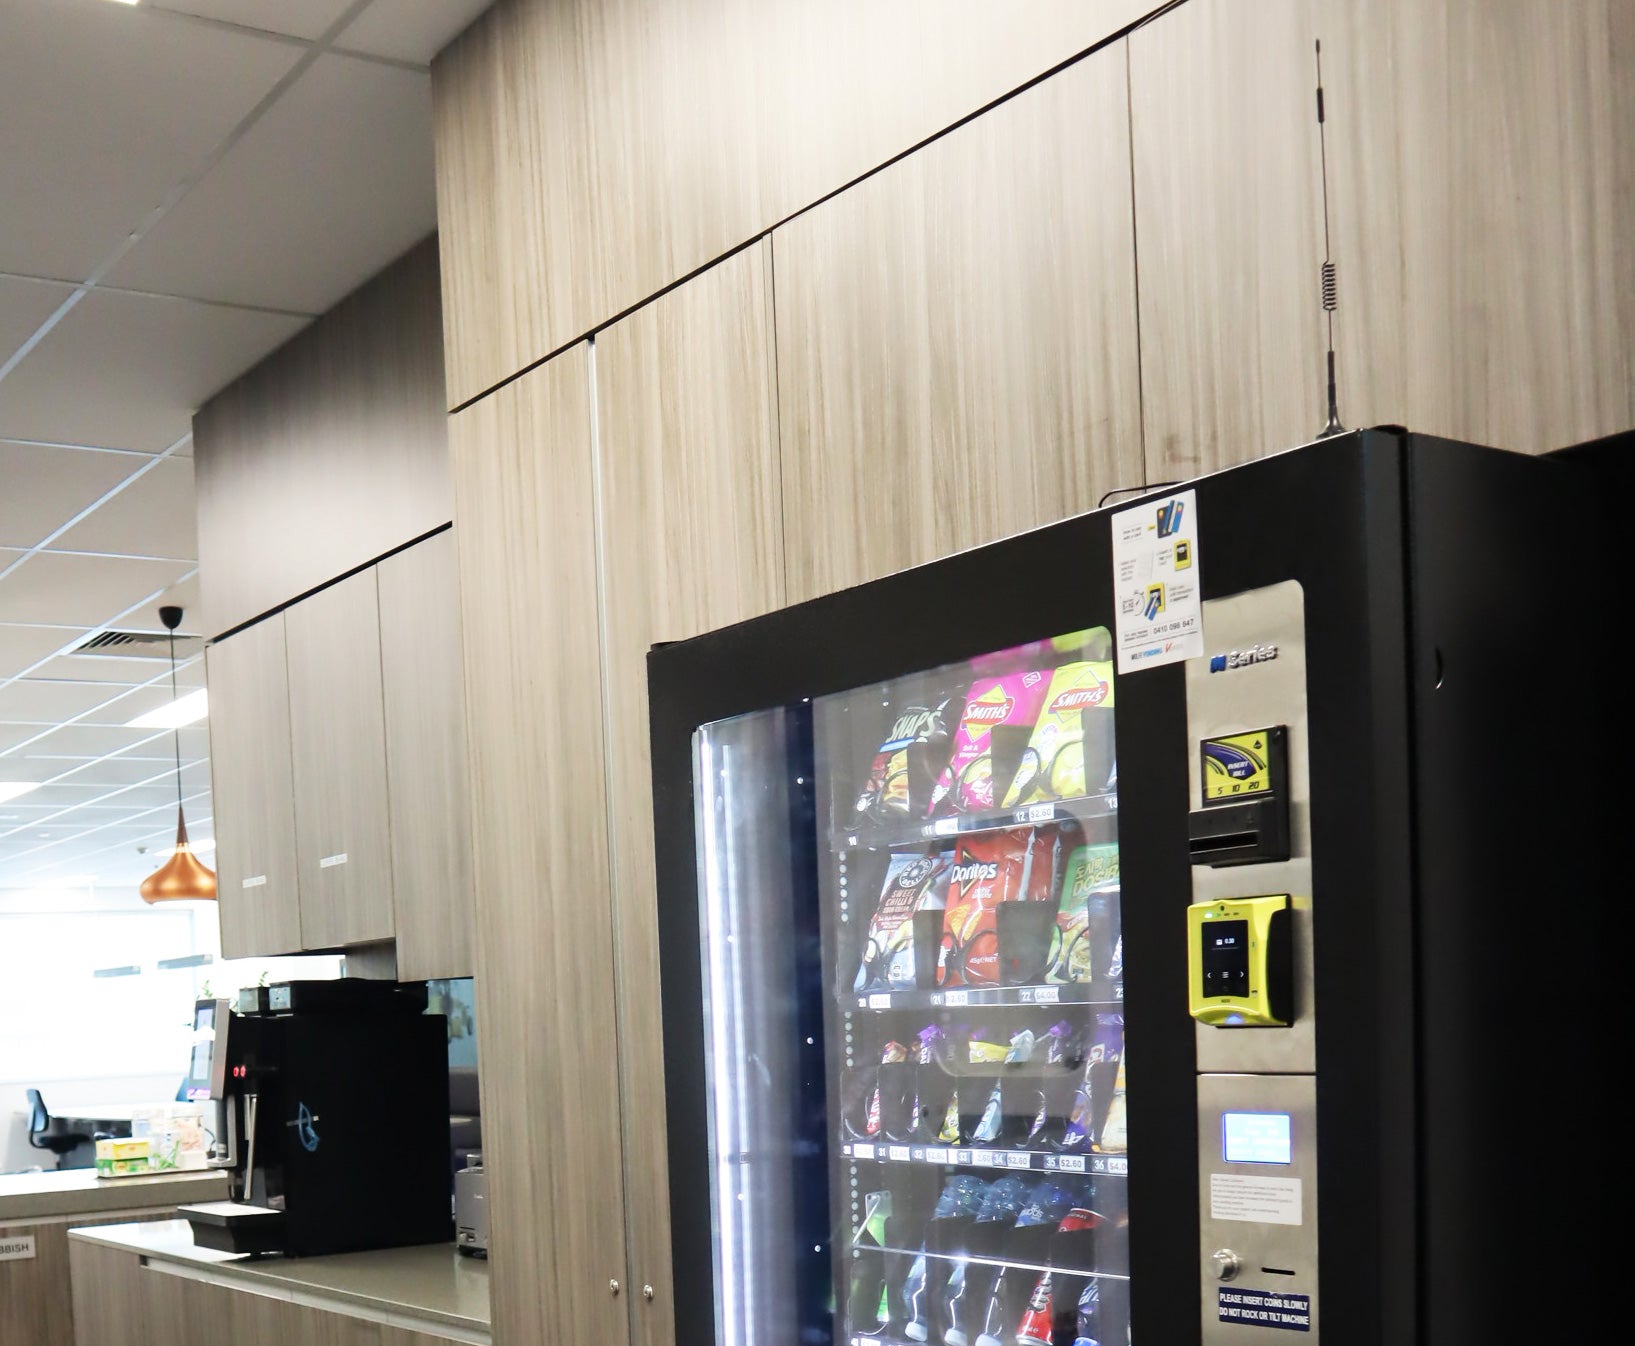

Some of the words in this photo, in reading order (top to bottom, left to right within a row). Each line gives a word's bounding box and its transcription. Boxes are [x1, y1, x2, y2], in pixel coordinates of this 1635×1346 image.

[1229, 644, 1278, 669] Series
[1052, 687, 1105, 708] SMITH'S
[963, 703, 1010, 720] SMITH'S
[886, 711, 942, 743] SNAPS
[1227, 761, 1249, 770] INSERT
[1217, 787, 1223, 795] 5
[1231, 784, 1240, 793] 10
[1248, 781, 1260, 790] 20
[1016, 811, 1025, 821] 12
[1030, 808, 1051, 818] $2.60
[951, 863, 998, 884] Doritos
[1022, 992, 1031, 1001] 22
[1008, 1156, 1028, 1165] $2.60
[1046, 1157, 1056, 1167] 35
[1061, 1159, 1082, 1168] $2.60
[1094, 1160, 1105, 1170] 36
[1220, 1293, 1242, 1303] PLEASE
[1243, 1295, 1263, 1306] INSERT
[1264, 1297, 1282, 1308] COINS
[1283, 1300, 1308, 1311] SLOWLY
[1220, 1307, 1228, 1316] DO
[1229, 1308, 1241, 1317] NOT
[1242, 1310, 1258, 1319] ROCK
[1259, 1311, 1268, 1320] OR
[1269, 1313, 1281, 1322] TILT
[1282, 1314, 1309, 1325] MACHINE
